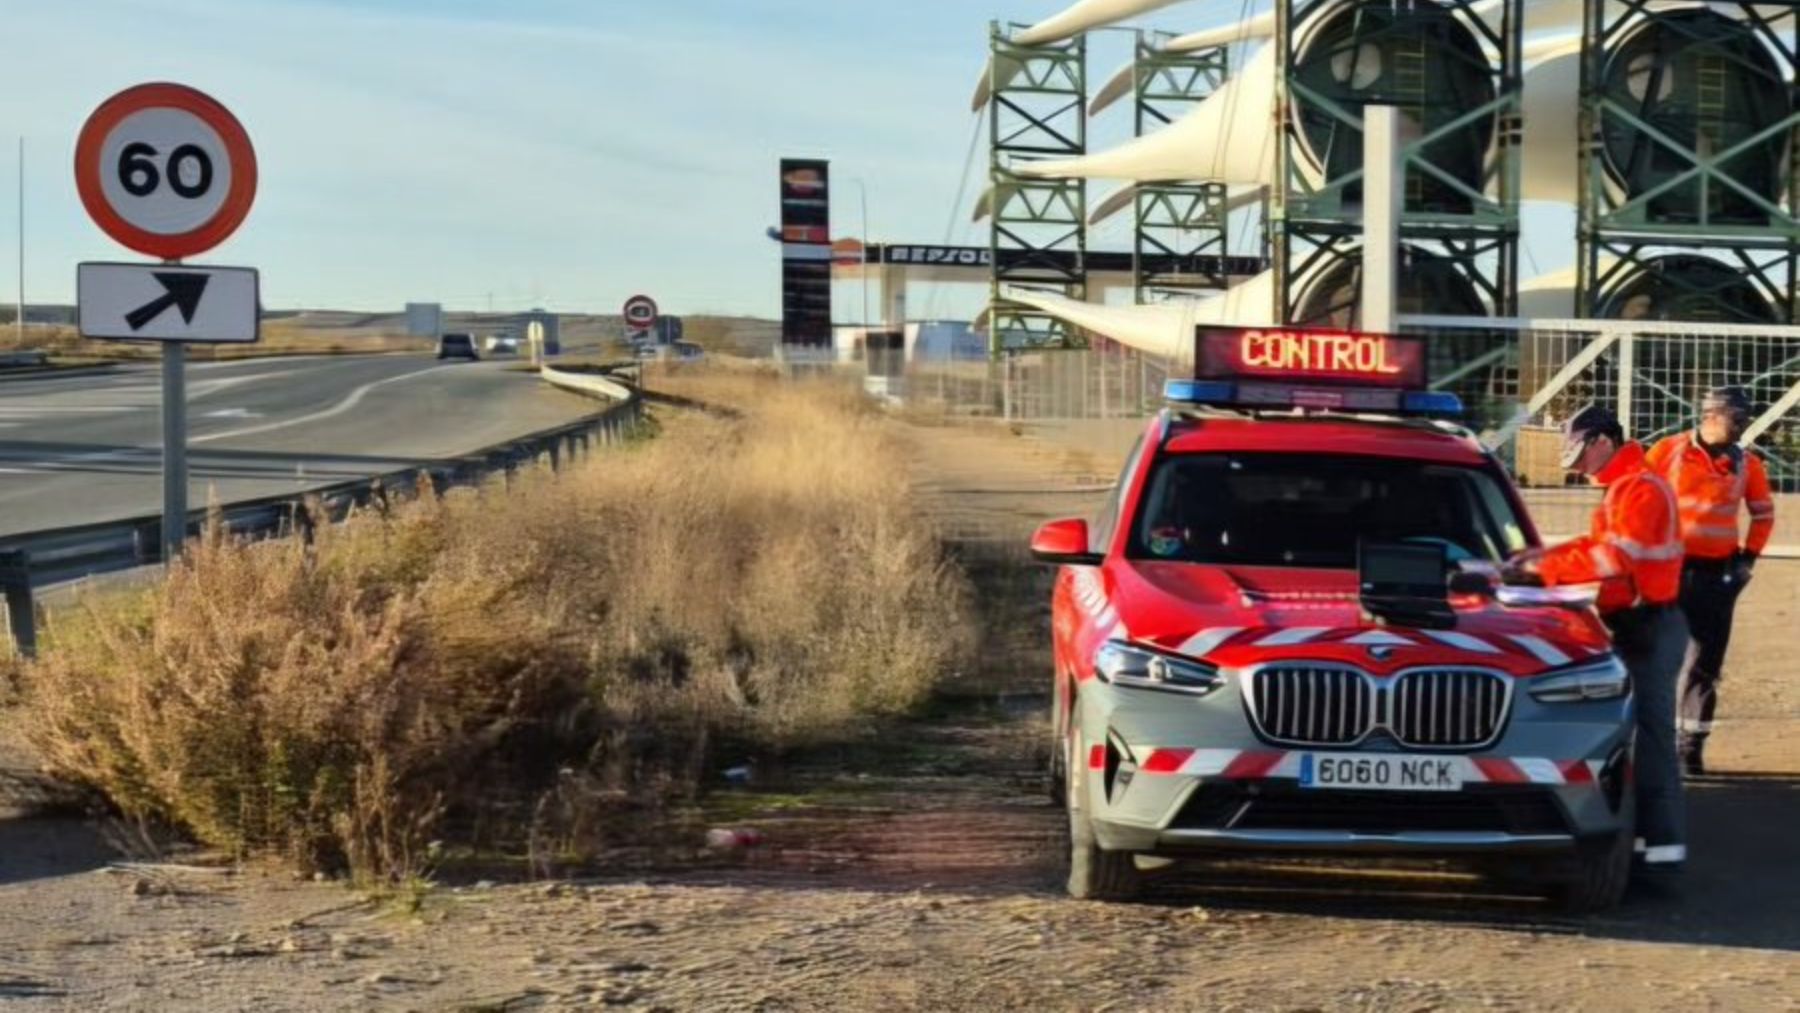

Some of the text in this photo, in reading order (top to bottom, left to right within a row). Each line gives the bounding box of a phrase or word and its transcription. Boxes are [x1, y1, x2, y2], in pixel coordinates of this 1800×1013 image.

[118, 142, 213, 199] 60
[1241, 330, 1400, 373] CONTROL
[1318, 758, 1453, 785] 6060 NCK
